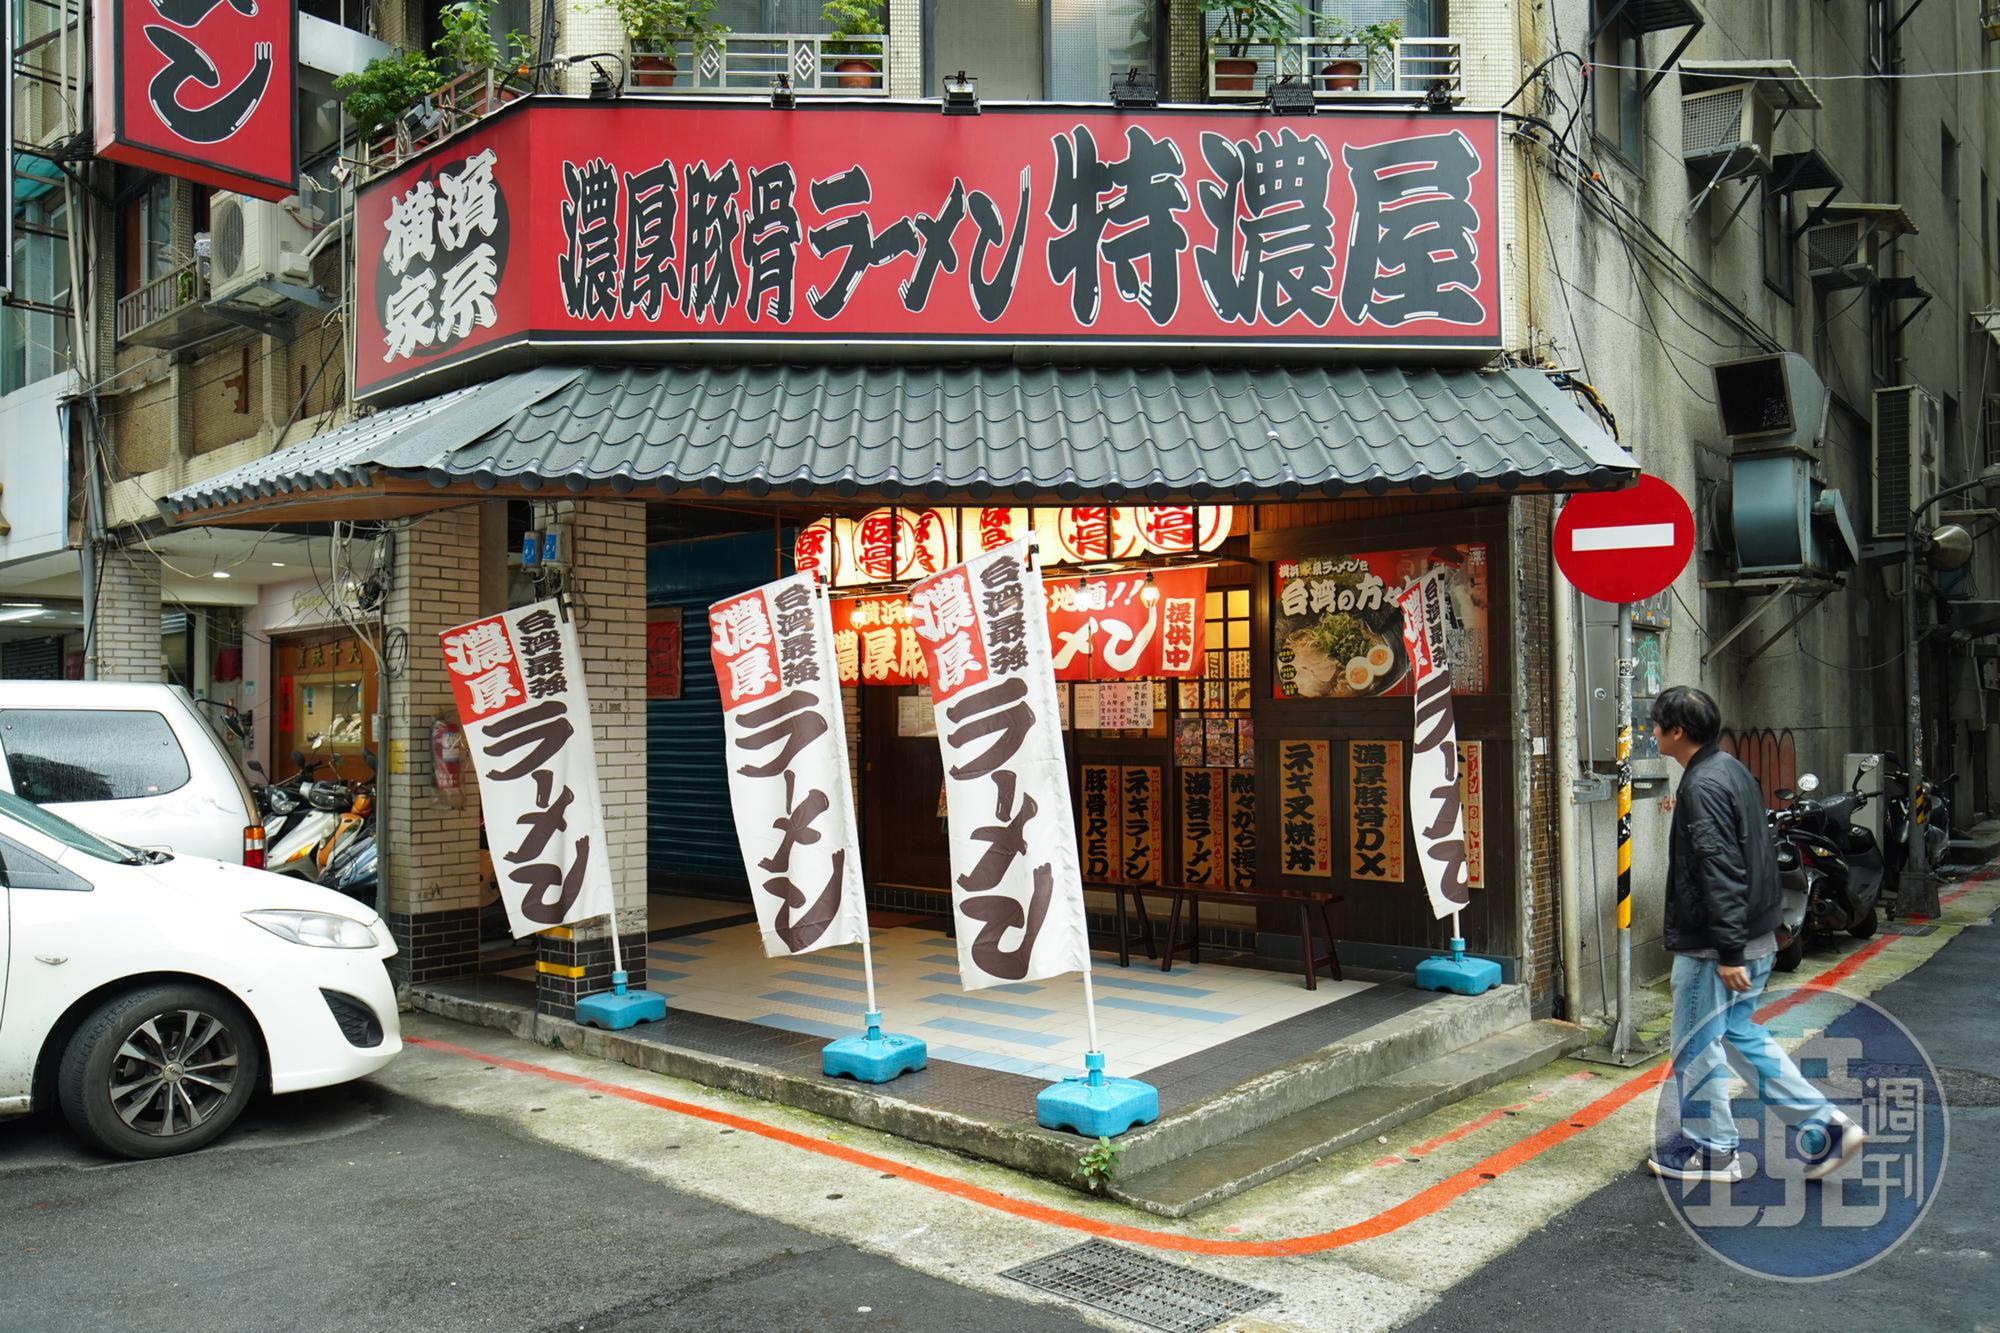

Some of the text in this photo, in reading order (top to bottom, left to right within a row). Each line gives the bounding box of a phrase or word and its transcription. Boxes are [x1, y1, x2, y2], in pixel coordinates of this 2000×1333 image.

[444, 621, 521, 714] 濃厚
[516, 609, 569, 699] 台湾最強
[710, 597, 779, 701] 濃厚
[774, 583, 821, 687] 台湾最強
[912, 572, 983, 693] 濃厚
[979, 555, 1029, 675] 台湾最強
[1165, 602, 1191, 668] 提供中
[481, 700, 590, 925] ラーメン
[735, 690, 845, 954] ラーメン
[946, 677, 1054, 980] ラーメン
[1085, 768, 1109, 877] 豚骨RED
[1124, 769, 1150, 879] ネギラーメン
